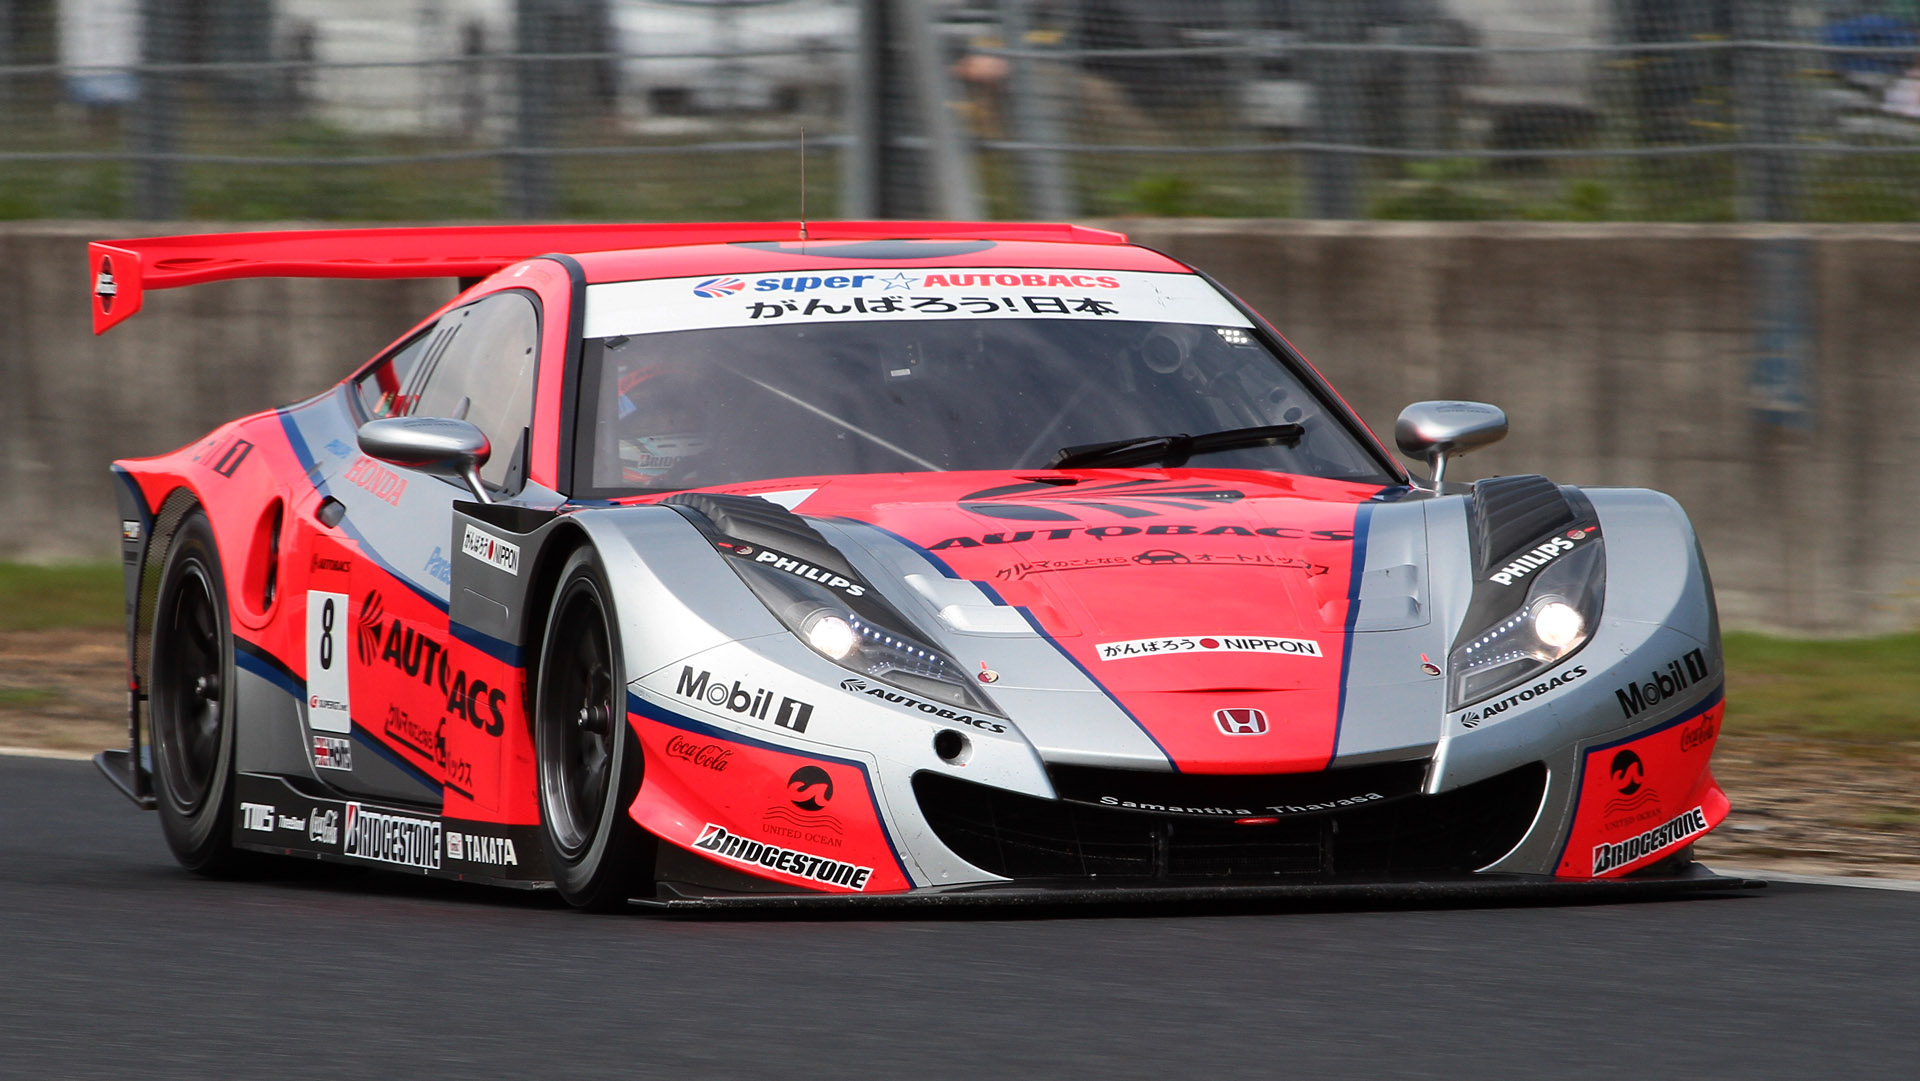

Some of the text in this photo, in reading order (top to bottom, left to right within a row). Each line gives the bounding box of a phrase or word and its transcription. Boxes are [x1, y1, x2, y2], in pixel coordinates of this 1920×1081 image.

[754, 273, 1121, 292] super AUTOBACS
[746, 296, 1120, 320] がんばろう!日本
[344, 456, 408, 506] HONDA
[493, 543, 519, 571] NIPPON
[928, 525, 1355, 551] AUTOBACS
[755, 551, 866, 596] PHILIPS
[995, 556, 1129, 581] クルマのことなら
[1490, 537, 1575, 586] PHILIPS
[320, 597, 335, 670] 8
[1104, 638, 1316, 657] がんばろう NIPPON
[676, 665, 774, 720] Mobil
[865, 688, 1008, 734] AUTOBACS
[1483, 665, 1588, 719] AUTOBACS
[1615, 660, 1688, 719] Mobil
[1100, 791, 1384, 816] Samantha Thavasa
[345, 802, 441, 867] BRIDGESTONE
[465, 835, 518, 866] TAKATA
[693, 824, 871, 889] BRIDGESTONE
[762, 824, 843, 848] UNITED OCEAN
[1593, 808, 1707, 875] BRIDGESTONE
